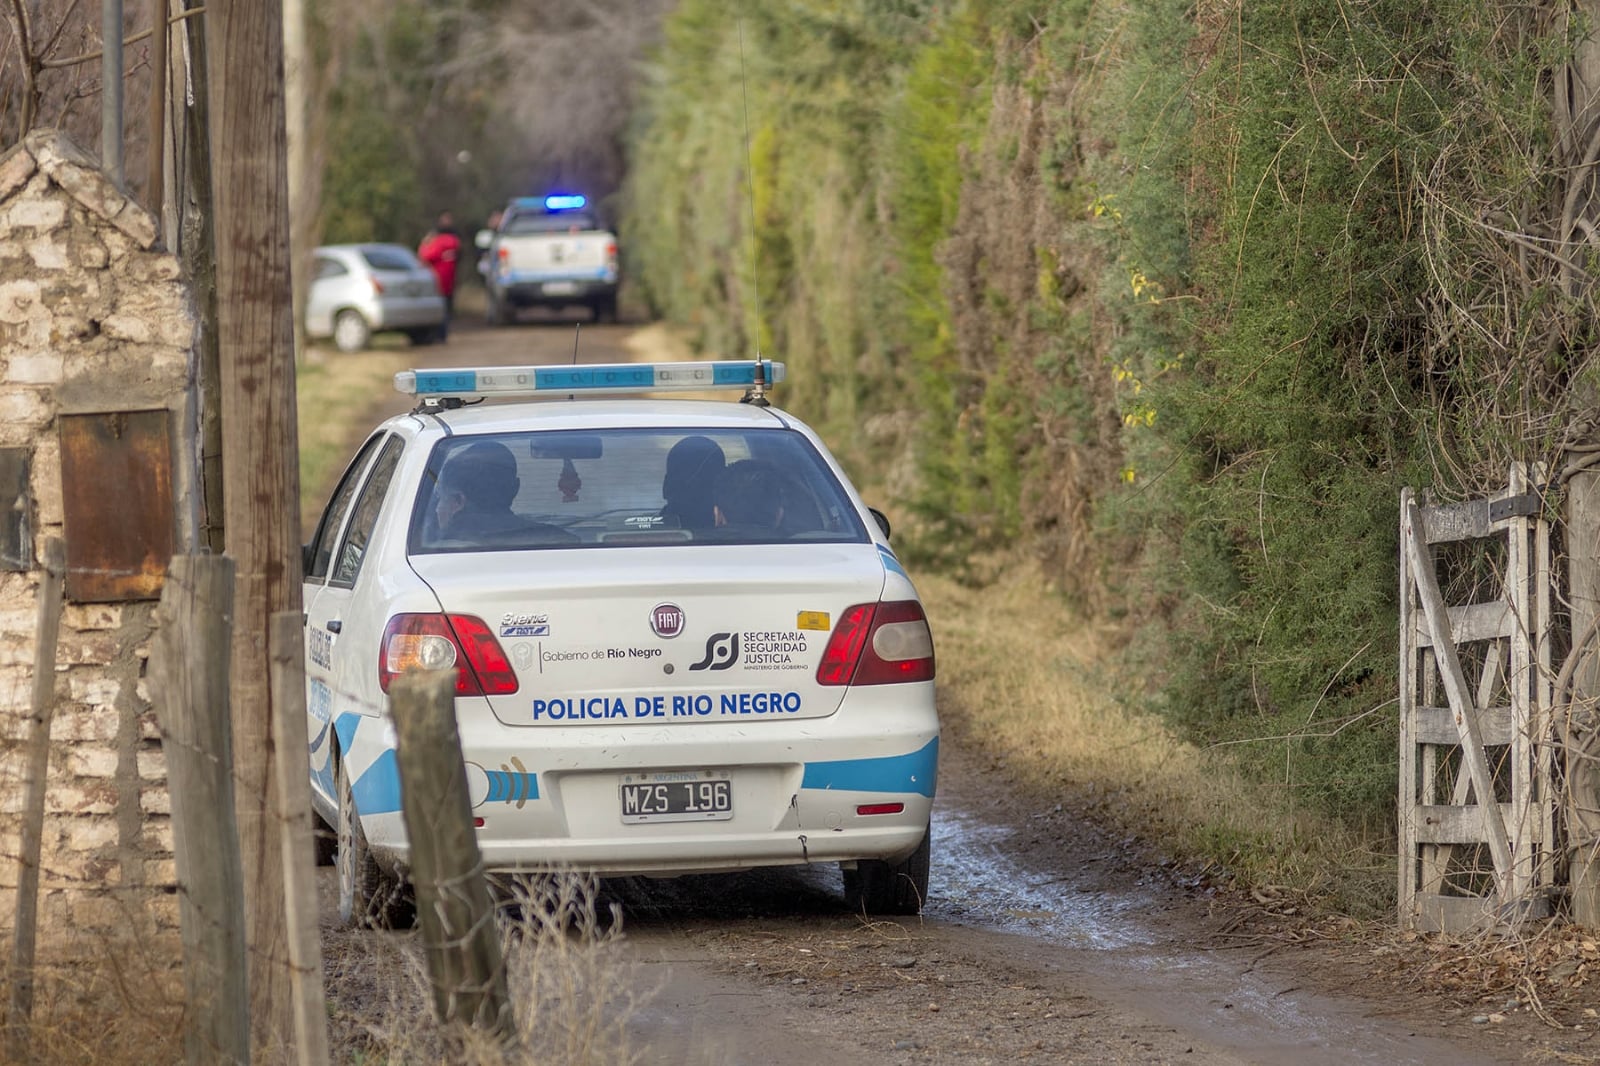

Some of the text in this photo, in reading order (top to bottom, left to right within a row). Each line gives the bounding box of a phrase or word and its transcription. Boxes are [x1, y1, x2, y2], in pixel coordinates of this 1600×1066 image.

[658, 612, 678, 629] FIAT
[743, 632, 806, 642] SECRETARIA
[542, 649, 589, 662] Gobierno
[591, 649, 605, 660] de
[628, 647, 662, 660] Negro
[744, 642, 807, 653] SEGURIDAD
[744, 653, 792, 664] JUSTICIA
[533, 692, 801, 720] POLICIA DE RIO NEGRO
[624, 783, 728, 814] MZS 196
